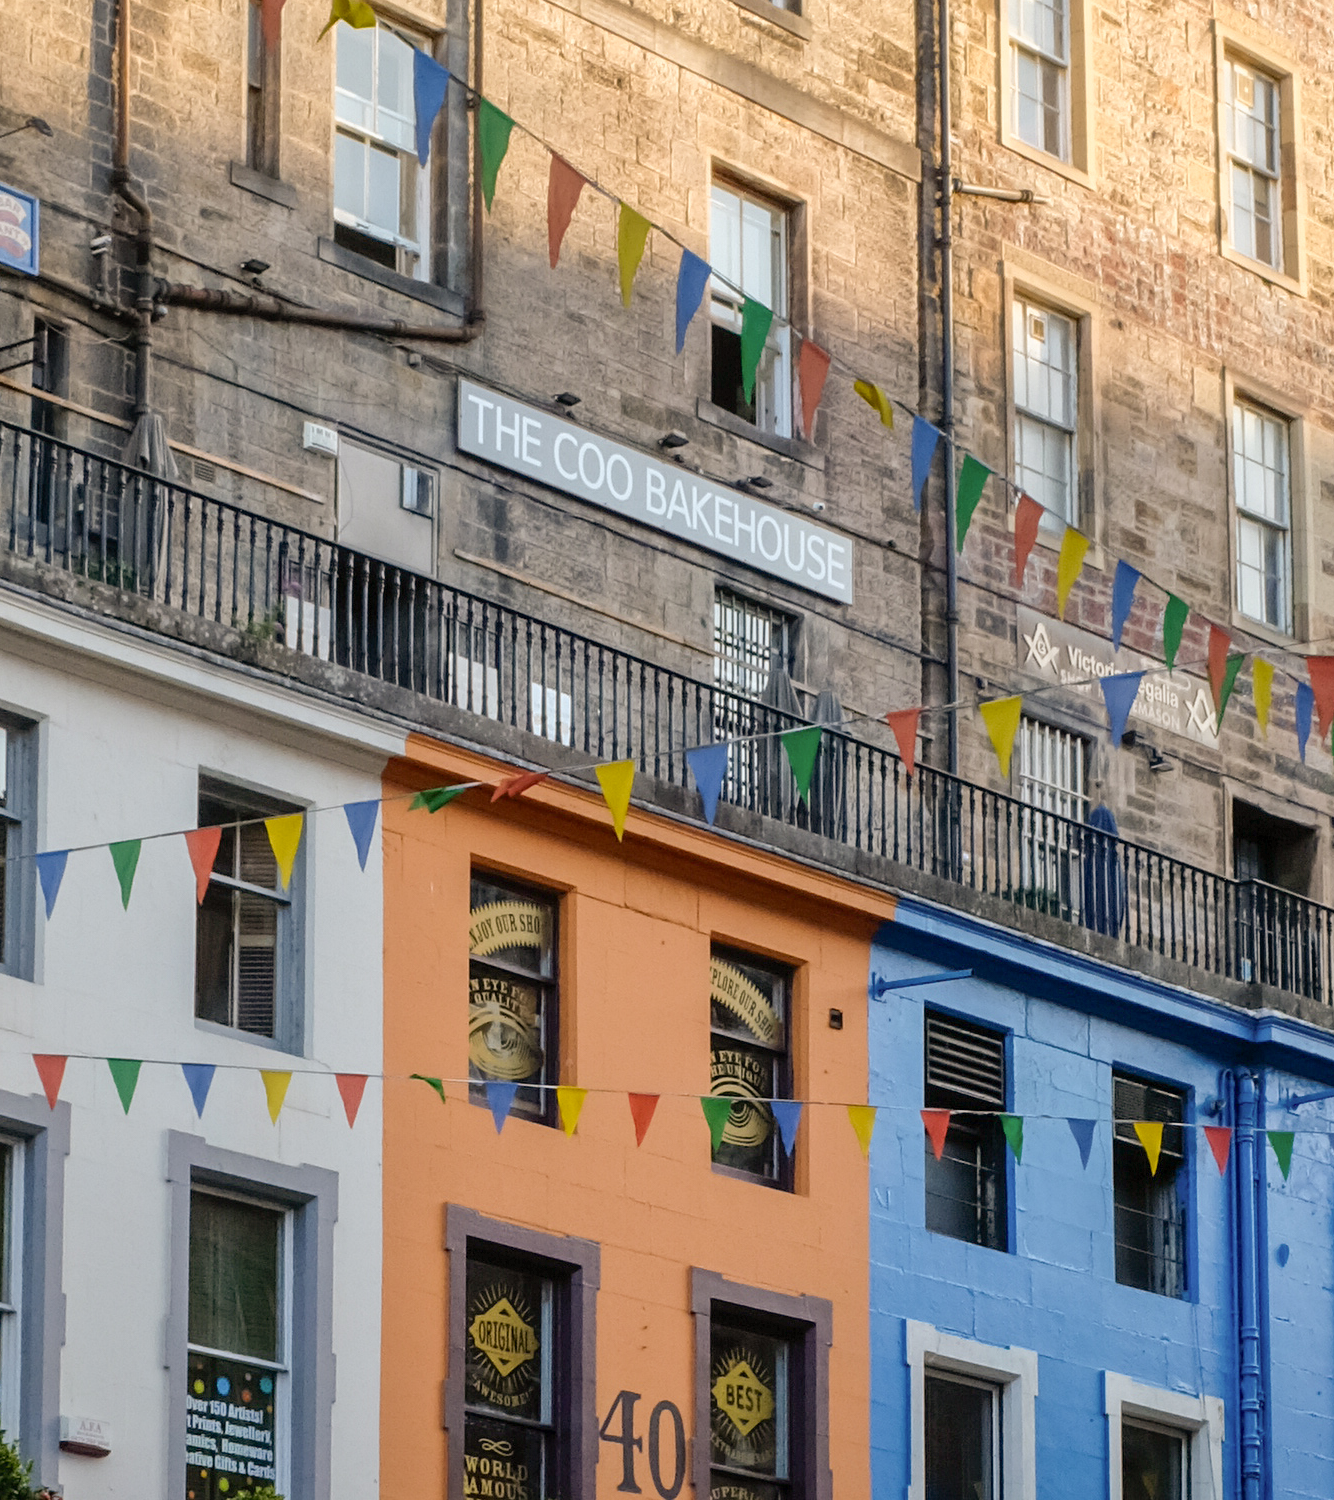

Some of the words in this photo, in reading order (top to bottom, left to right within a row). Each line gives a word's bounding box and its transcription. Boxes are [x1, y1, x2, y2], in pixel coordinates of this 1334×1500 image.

[468, 393, 543, 468] THE
[553, 432, 633, 501] COO
[645, 467, 846, 591] BAKEHOUSE
[1136, 678, 1179, 710] egalia
[469, 918, 495, 952] NJOY
[496, 913, 518, 935] OUR
[482, 978, 508, 995] EYE
[710, 966, 740, 1000] PLORE
[739, 989, 757, 1017] OUR
[474, 992, 528, 1014] QUALIT
[711, 1063, 725, 1076] HE
[718, 1049, 742, 1064] EYE
[478, 1320, 531, 1354] ORIGINAL
[209, 1399, 227, 1417] 150
[726, 1383, 763, 1413] BEST
[599, 1389, 687, 1500] 40
[214, 1454, 238, 1473] Gifts
[238, 1460, 247, 1475] &
[465, 1454, 529, 1482] WORLD
